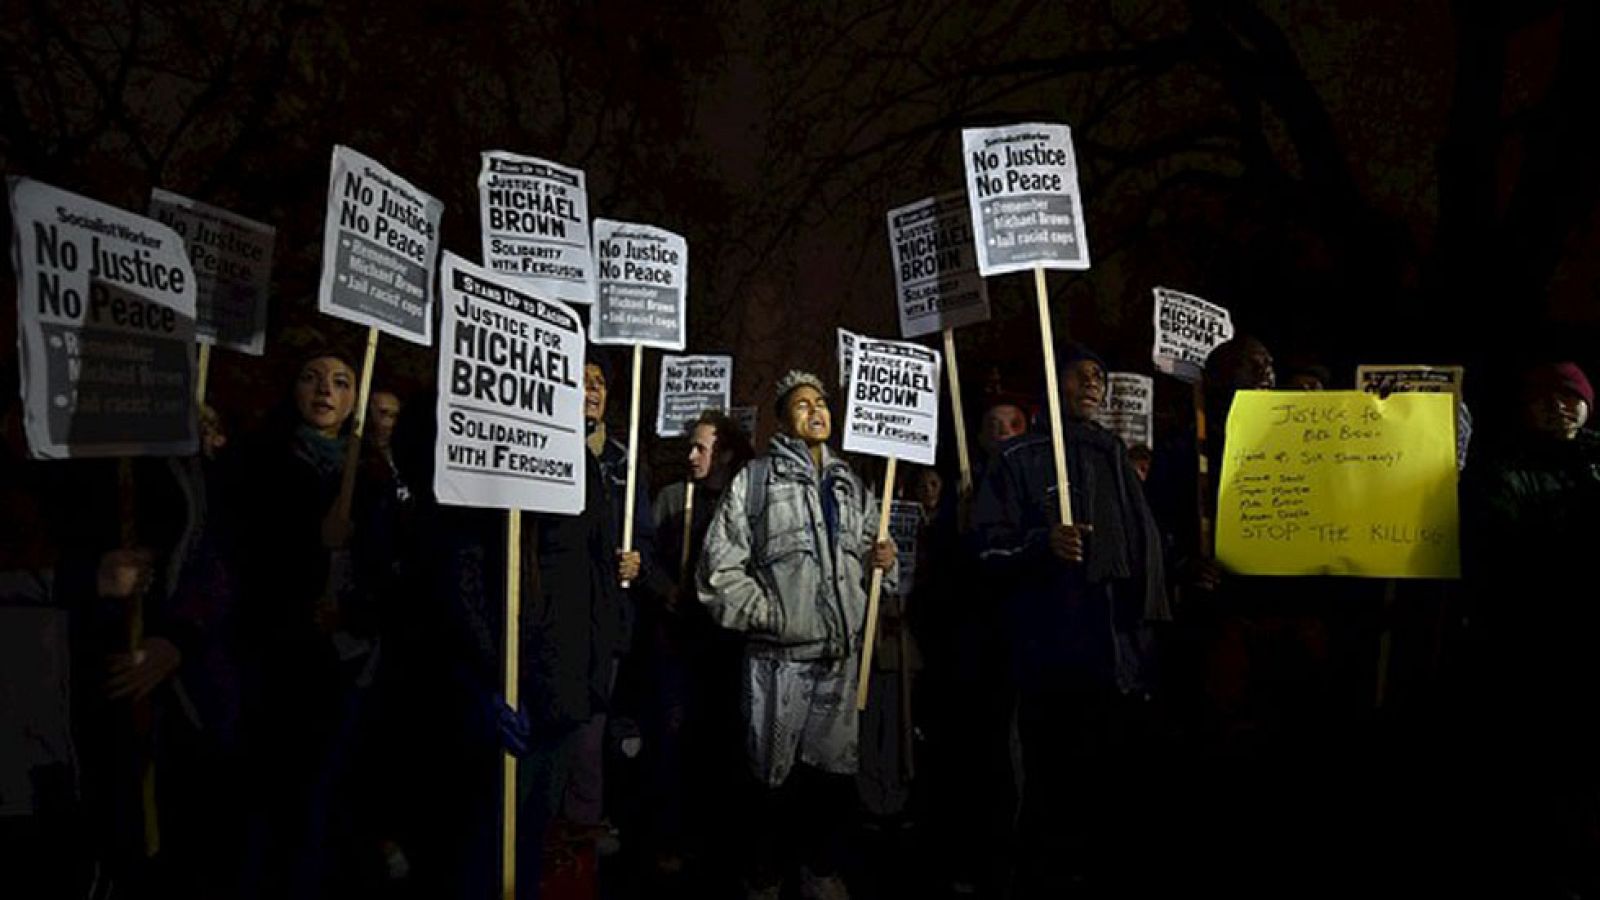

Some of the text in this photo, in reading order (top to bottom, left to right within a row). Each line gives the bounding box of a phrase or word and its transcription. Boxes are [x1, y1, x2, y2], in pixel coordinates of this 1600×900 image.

[973, 142, 1066, 173] No Justice
[488, 175, 566, 196] JUSTICE FOR
[976, 170, 1062, 198] No Peace
[344, 171, 434, 240] No Justice
[489, 190, 581, 222] MICHAEL
[340, 200, 425, 262] No Peace
[490, 207, 566, 238] BROWN
[33, 221, 185, 293] No Justice
[492, 239, 562, 258] SOLIDARITY
[600, 240, 679, 265] No Justice
[492, 258, 583, 277] WITH FERGUSON
[600, 260, 672, 285] No Peace
[902, 248, 961, 282] BROWN
[37, 272, 81, 319] No
[90, 282, 176, 333] Peace
[463, 276, 500, 302] STAND
[504, 289, 520, 310] UP
[455, 295, 561, 350] JUSTICE FOR
[1161, 307, 1227, 339] MICHAEL
[455, 319, 577, 389] MICHAEL
[451, 359, 555, 416] BROWN
[667, 367, 683, 378] No
[857, 364, 934, 392] MICHAEL
[857, 382, 918, 407] BROWN
[449, 411, 548, 450] SOLIDARITY
[448, 444, 574, 479] WITH FERGUSON
[1241, 522, 1301, 542] STOP
[1310, 522, 1352, 544] THE
